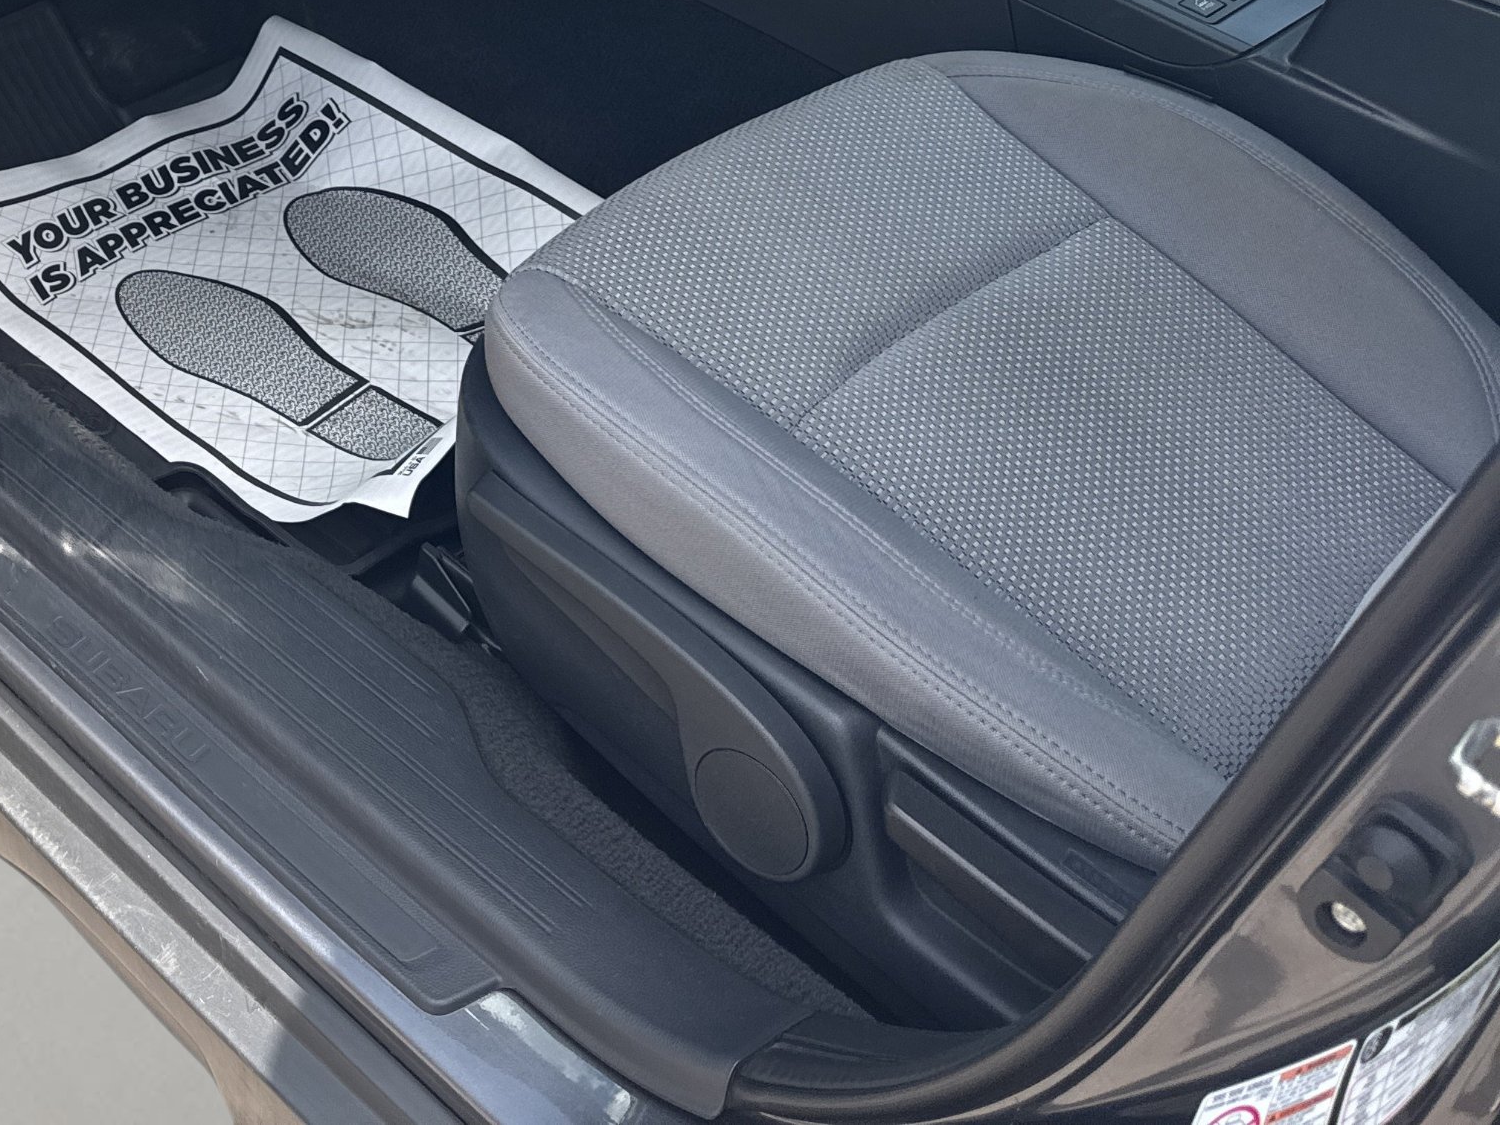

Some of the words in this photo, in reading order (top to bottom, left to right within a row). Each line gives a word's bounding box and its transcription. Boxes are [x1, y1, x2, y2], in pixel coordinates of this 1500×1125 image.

[7, 194, 118, 268] YOUR
[115, 92, 308, 212] BUSINESS
[27, 262, 76, 305] IS
[76, 98, 351, 277] APPRECIATED!
[402, 457, 426, 477] USA
